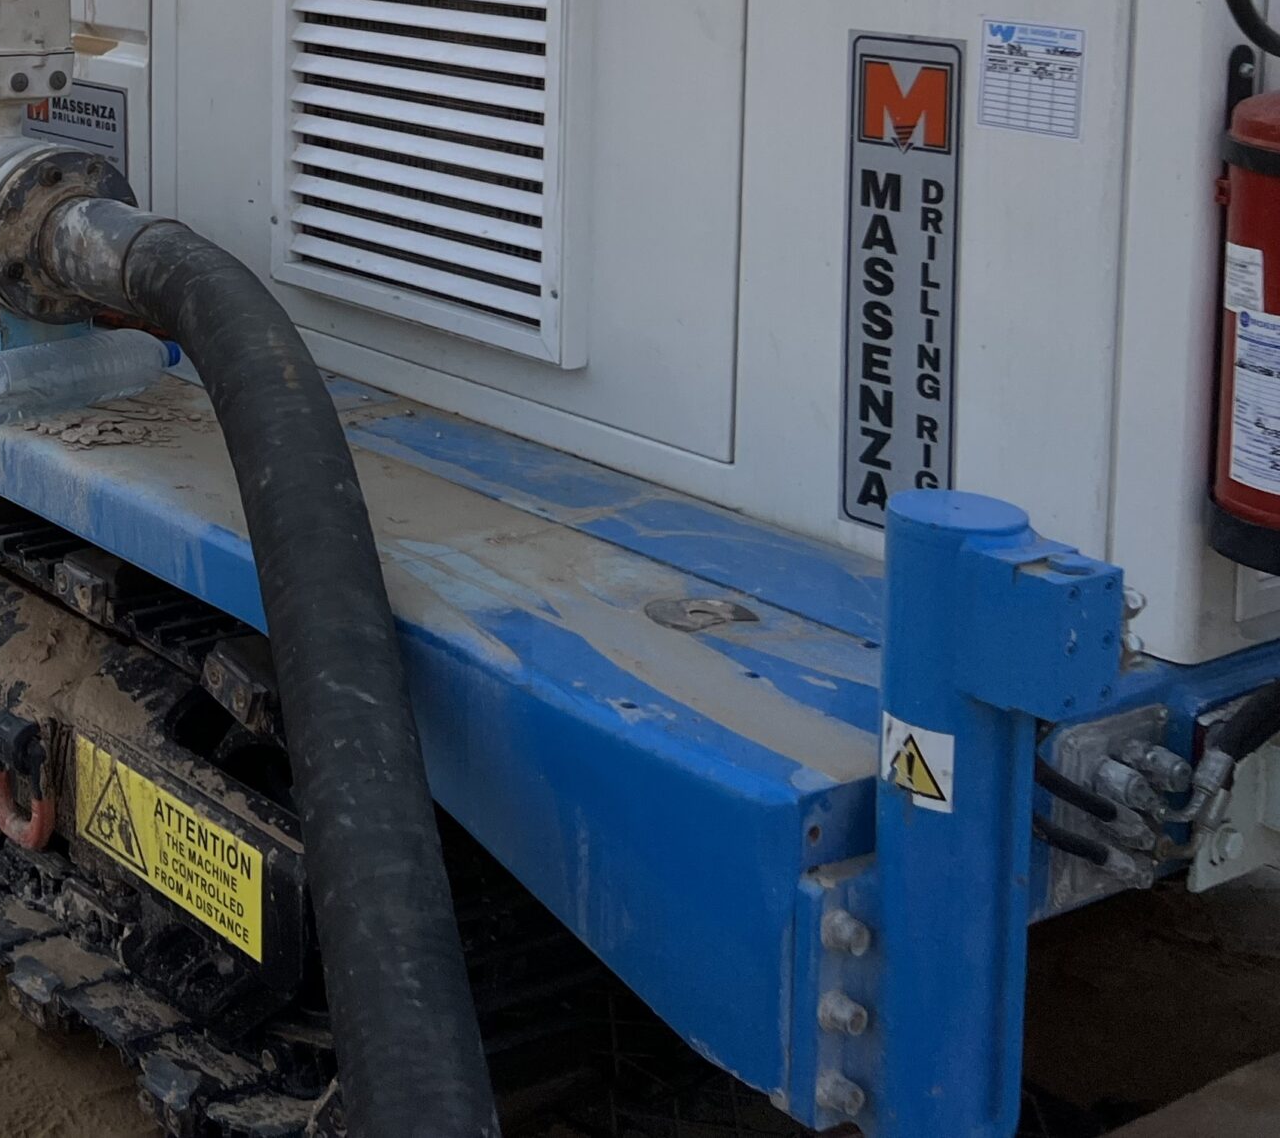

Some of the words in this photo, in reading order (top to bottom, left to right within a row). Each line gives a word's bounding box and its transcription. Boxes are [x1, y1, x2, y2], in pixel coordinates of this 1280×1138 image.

[52, 97, 116, 121] MASSENZA
[52, 111, 92, 127] DRILLING
[96, 120, 117, 132] RIGS
[917, 178, 944, 401] DRILLING
[856, 169, 901, 511] MASSENZA
[154, 798, 251, 880] ATTENTION
[166, 832, 185, 858] THE
[188, 848, 238, 893] MACHINE
[155, 866, 183, 897] FROM
[186, 888, 194, 905] A
[196, 895, 249, 944] DISTANCE
[160, 849, 169, 866] IS
[172, 858, 244, 918] CONTROLLED
